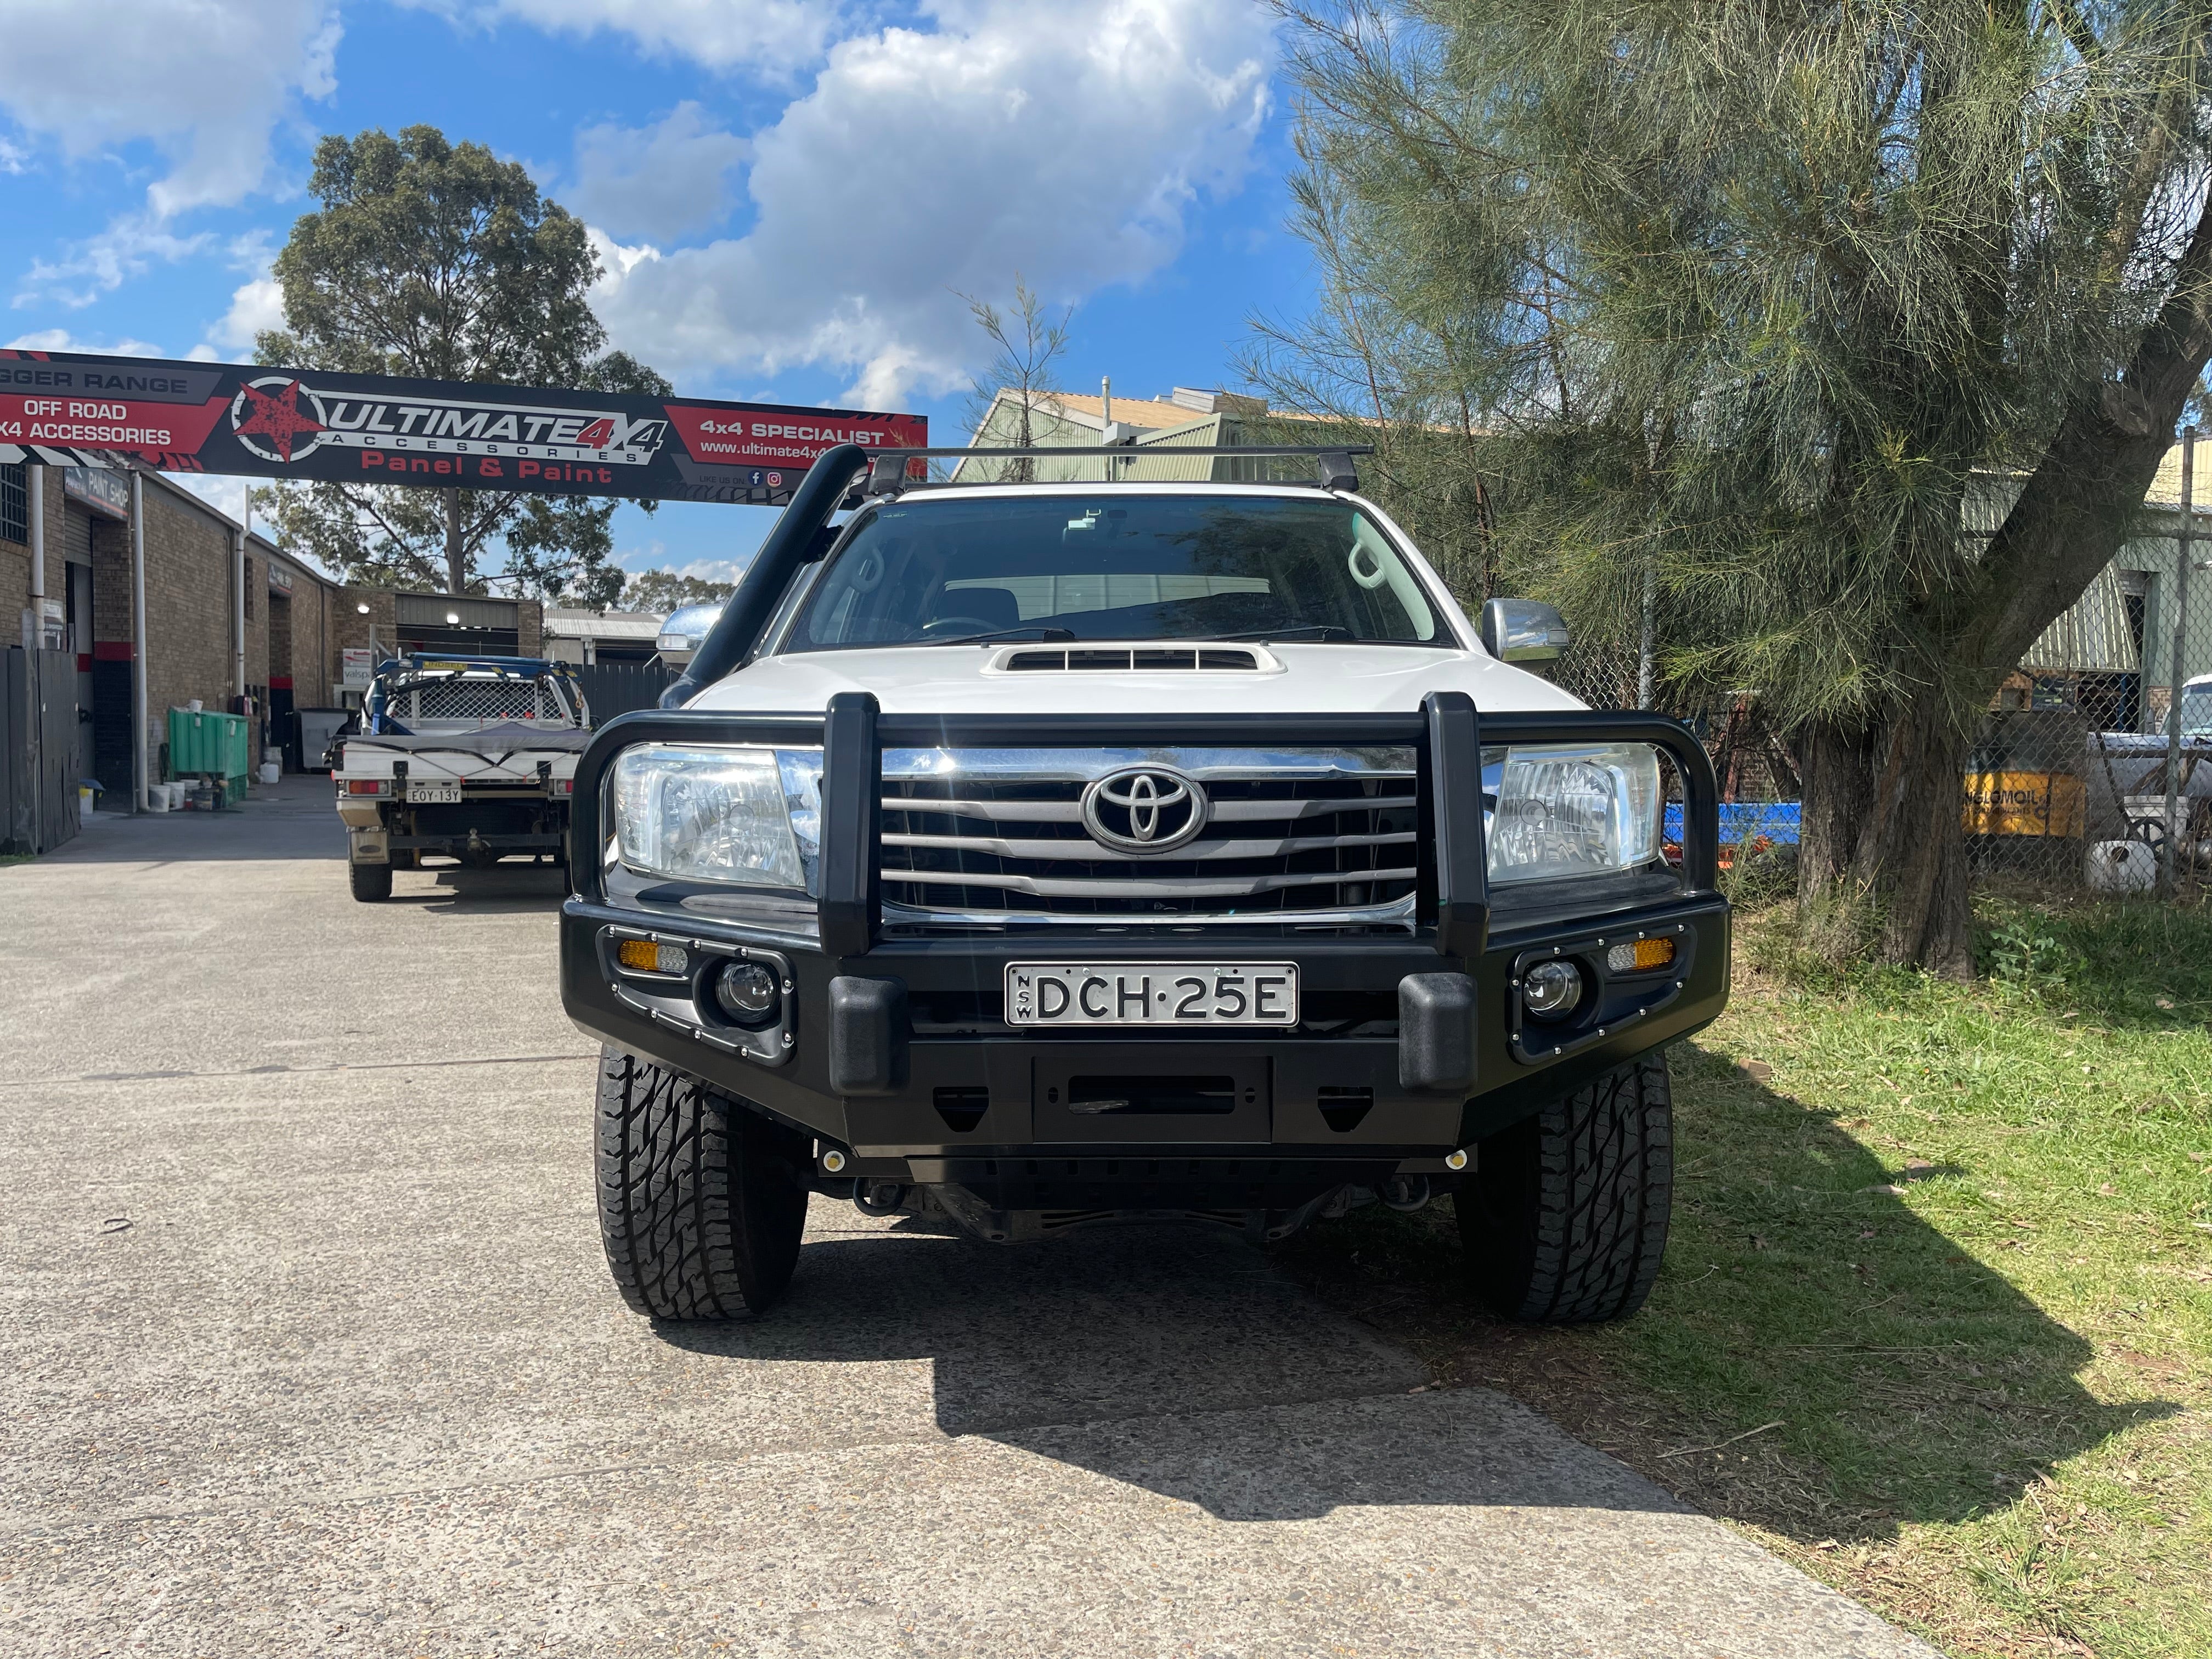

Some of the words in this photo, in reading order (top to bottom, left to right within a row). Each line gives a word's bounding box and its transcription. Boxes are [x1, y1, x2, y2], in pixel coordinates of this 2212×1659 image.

[84, 374, 188, 394] RANGE
[24, 400, 62, 416] OFF
[69, 402, 127, 420] ROAD
[29, 422, 171, 445] ACCESSORIES
[700, 420, 743, 435] 4x4
[751, 423, 885, 445] SPECIALIST
[331, 434, 636, 462] ACCESSORIES
[361, 450, 462, 475] Panel
[479, 458, 504, 477] &
[518, 460, 612, 483] Paint
[88, 471, 108, 499] PAINT
[110, 483, 129, 508] SHOP
[345, 669, 370, 680] valsp
